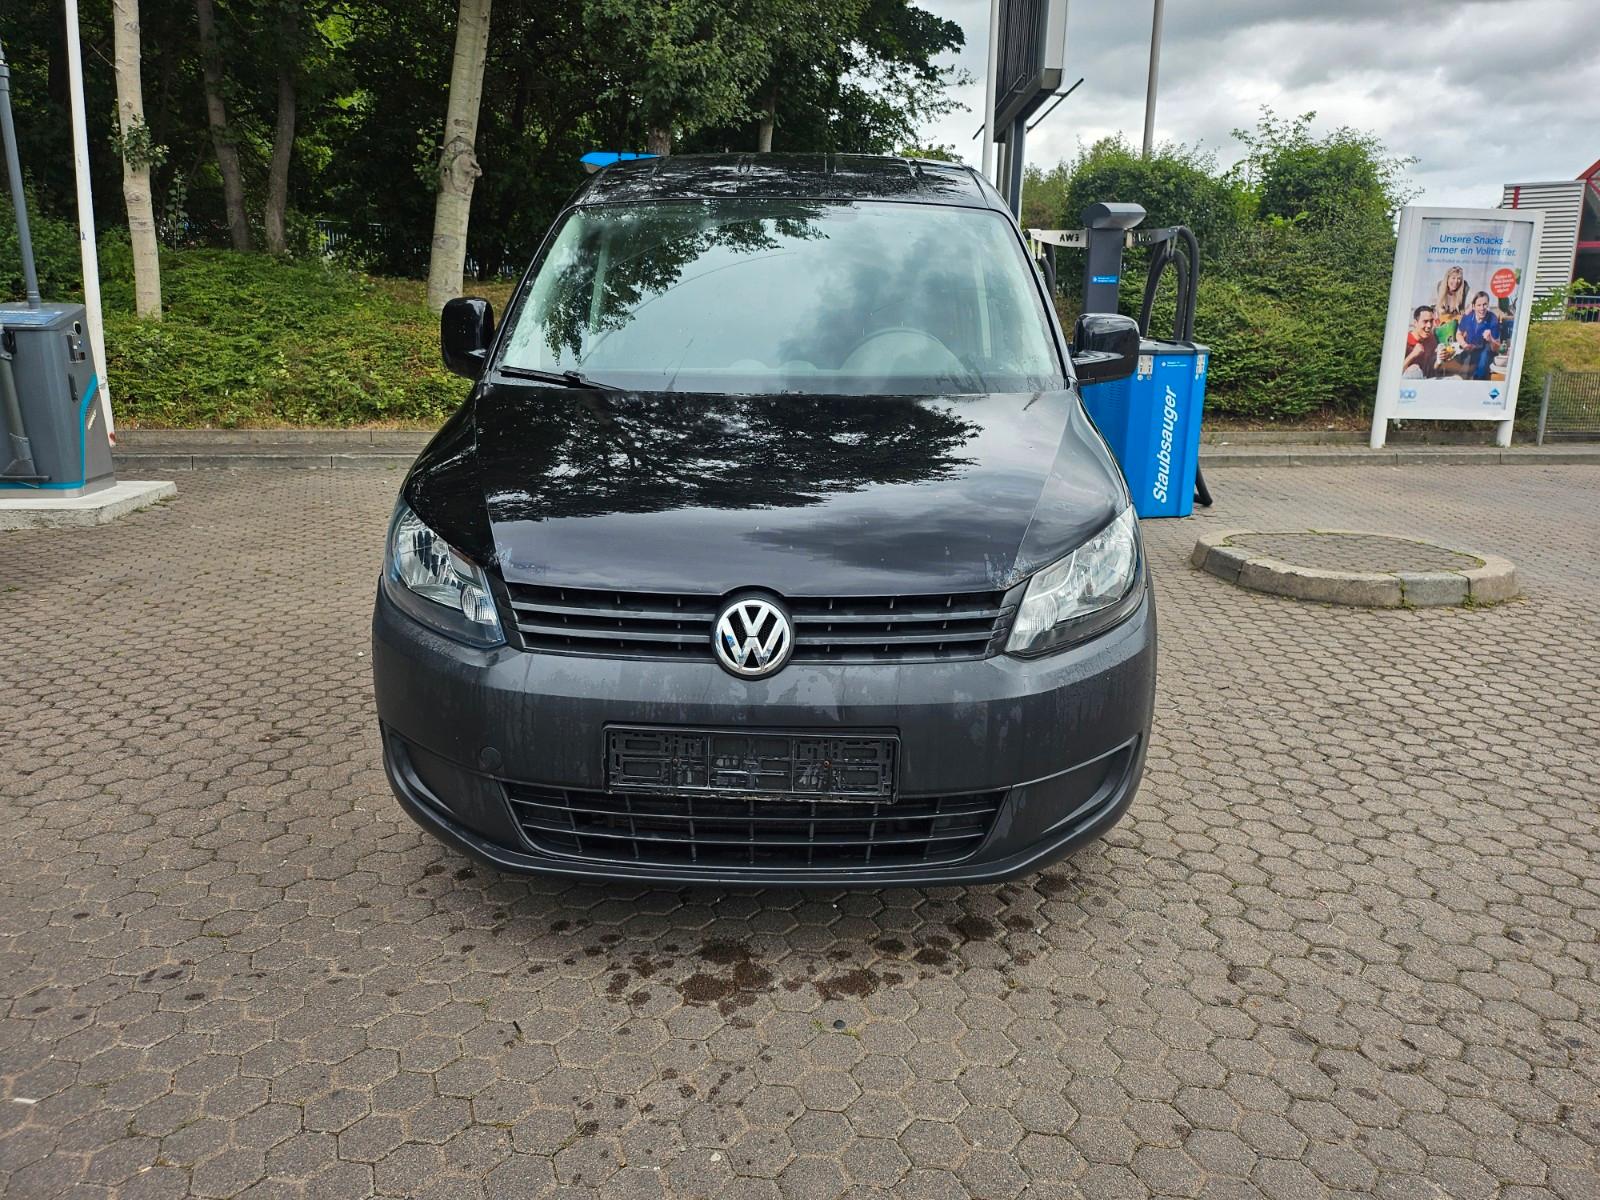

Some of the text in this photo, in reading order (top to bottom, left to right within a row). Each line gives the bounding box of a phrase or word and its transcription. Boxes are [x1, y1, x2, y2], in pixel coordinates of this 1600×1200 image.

[1428, 245, 1458, 254] immer
[1460, 246, 1473, 255] ein
[1439, 234, 1472, 244] Unsere
[1473, 235, 1504, 245] Snacks
[1152, 384, 1178, 504] Staubsauger
[716, 600, 790, 675] VW
